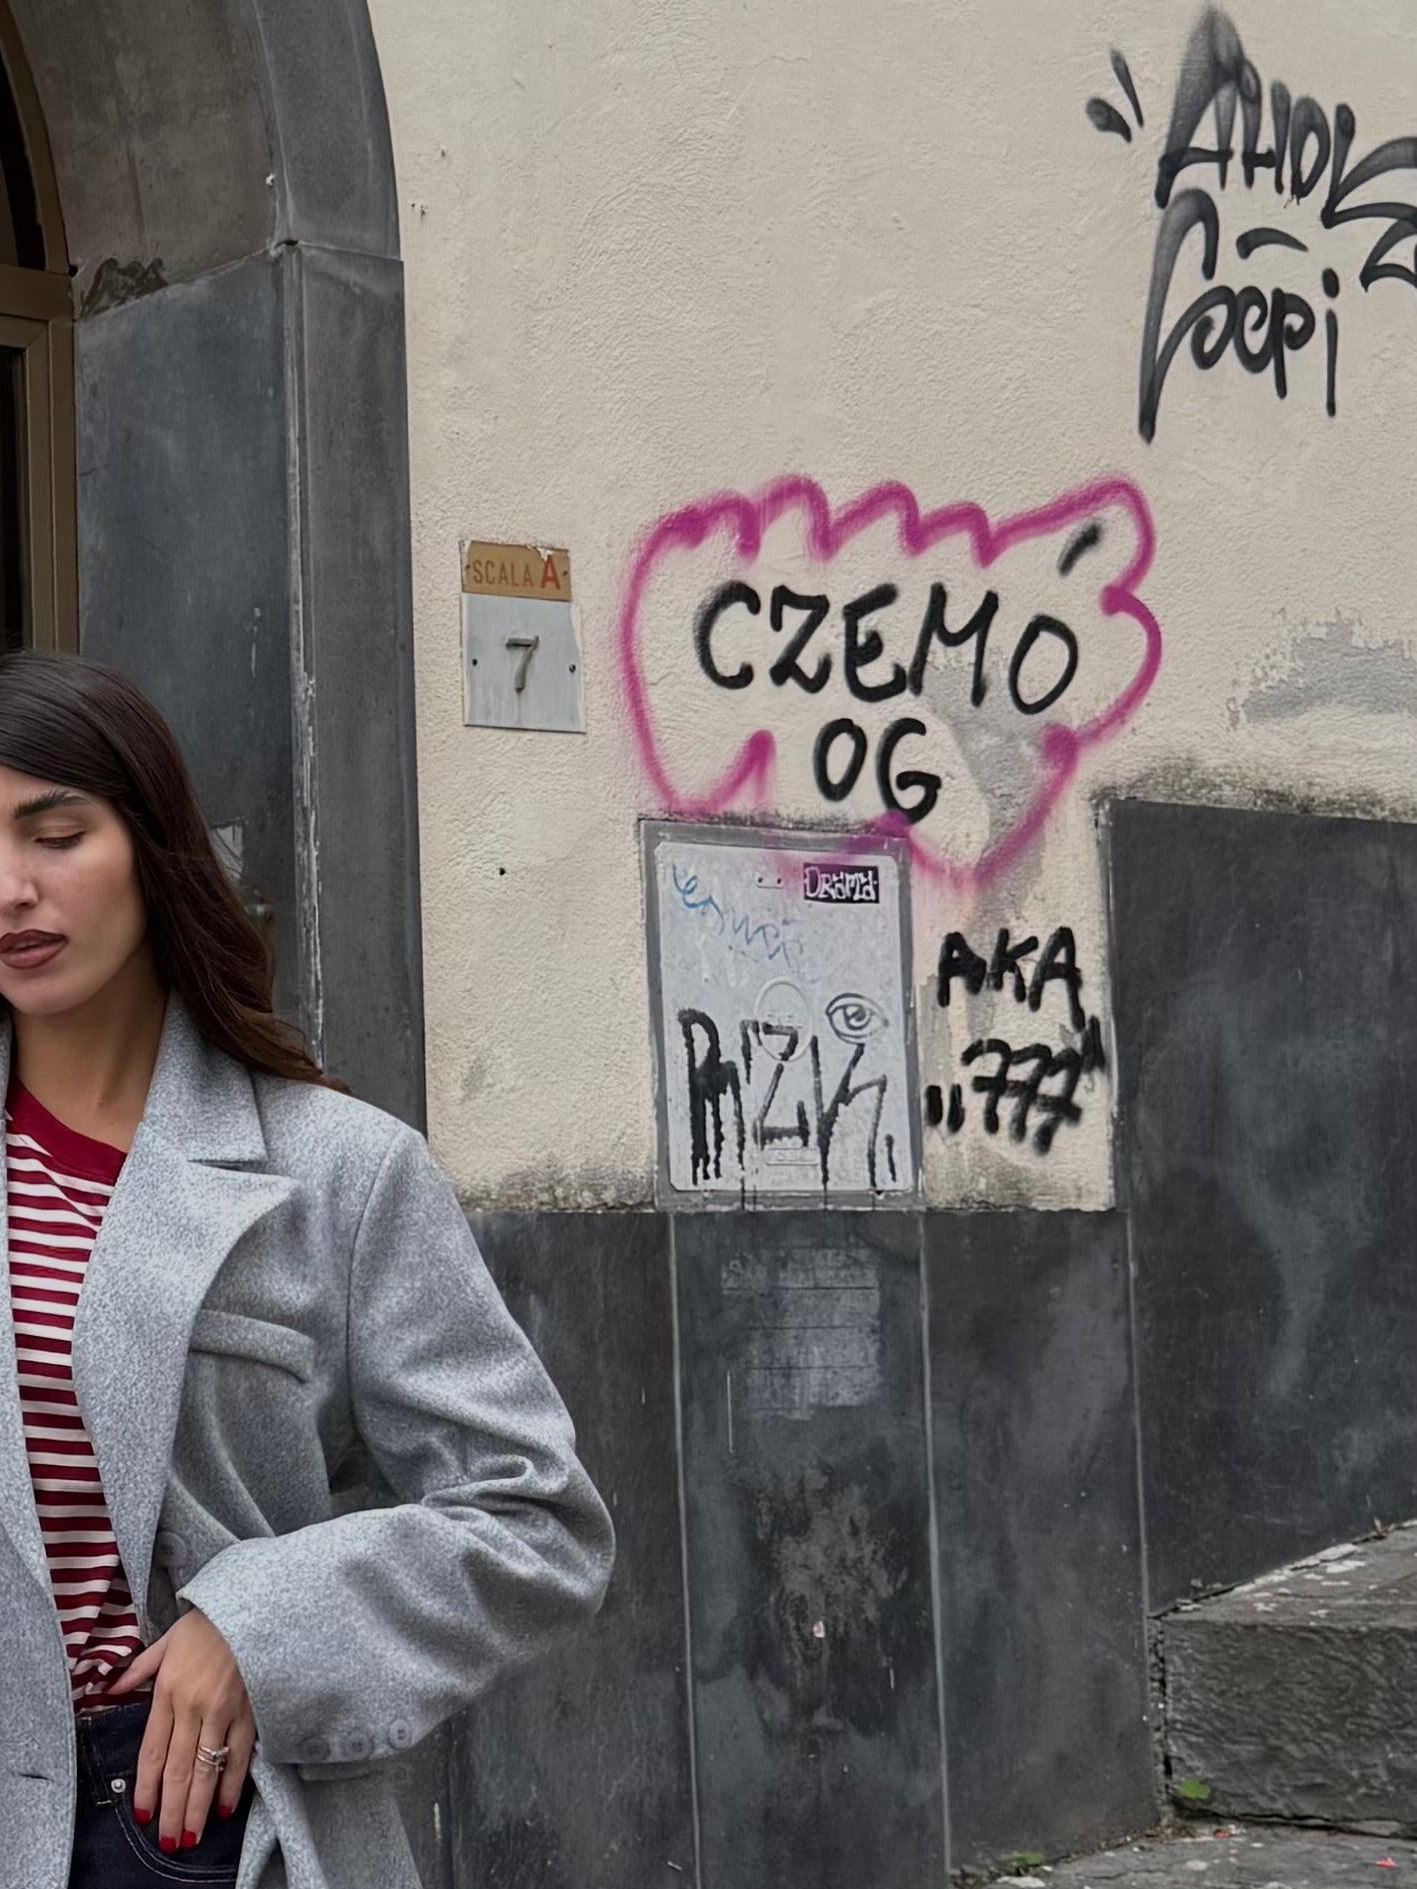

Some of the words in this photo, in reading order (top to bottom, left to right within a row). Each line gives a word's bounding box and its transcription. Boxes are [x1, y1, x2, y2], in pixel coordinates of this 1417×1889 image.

[472, 559, 534, 588] SCALA
[541, 555, 561, 590] A
[505, 635, 540, 693] 7
[695, 581, 1079, 716] CZEMO
[813, 717, 943, 825] OG
[938, 926, 1085, 1032] AKA
